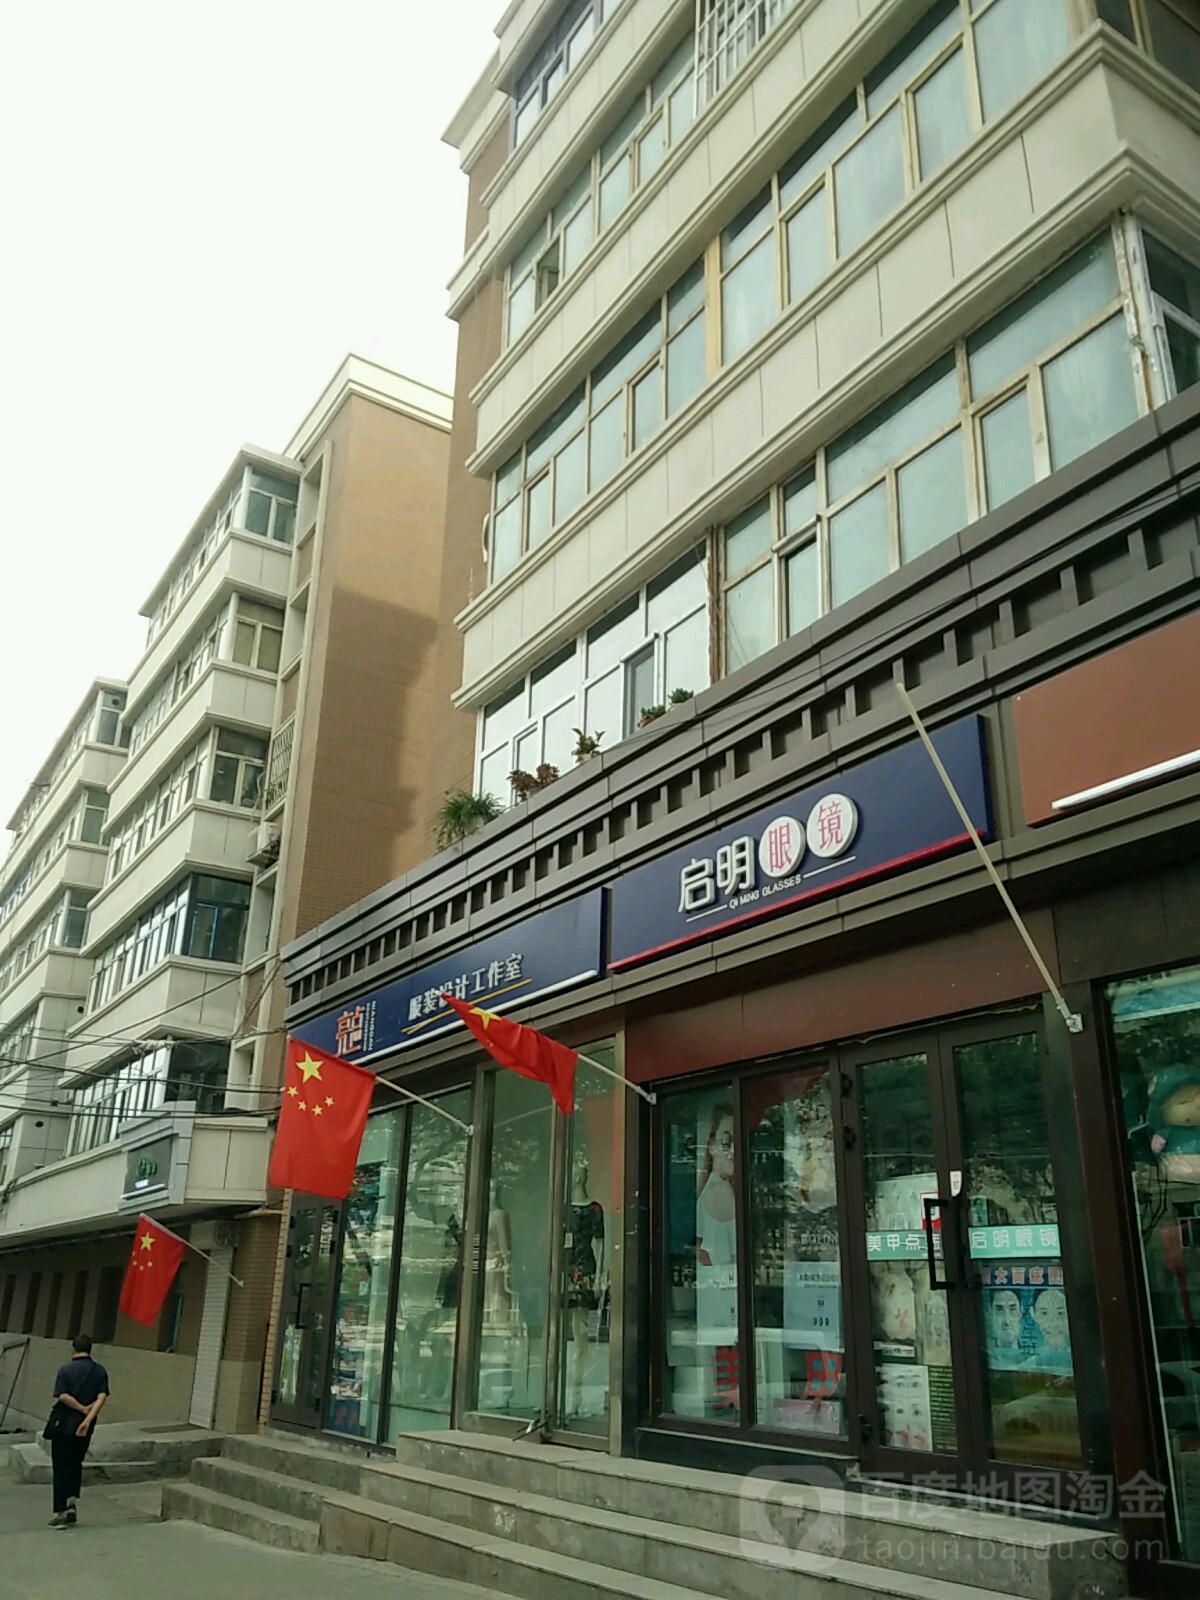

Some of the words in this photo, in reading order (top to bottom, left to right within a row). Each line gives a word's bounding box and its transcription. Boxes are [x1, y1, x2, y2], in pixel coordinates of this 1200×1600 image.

[678, 799, 846, 913] 启明眼镜
[729, 898, 740, 910] QI
[739, 891, 760, 908] MING
[761, 873, 803, 898] GLASSES
[971, 1228, 1058, 1249] 启明眼镜
